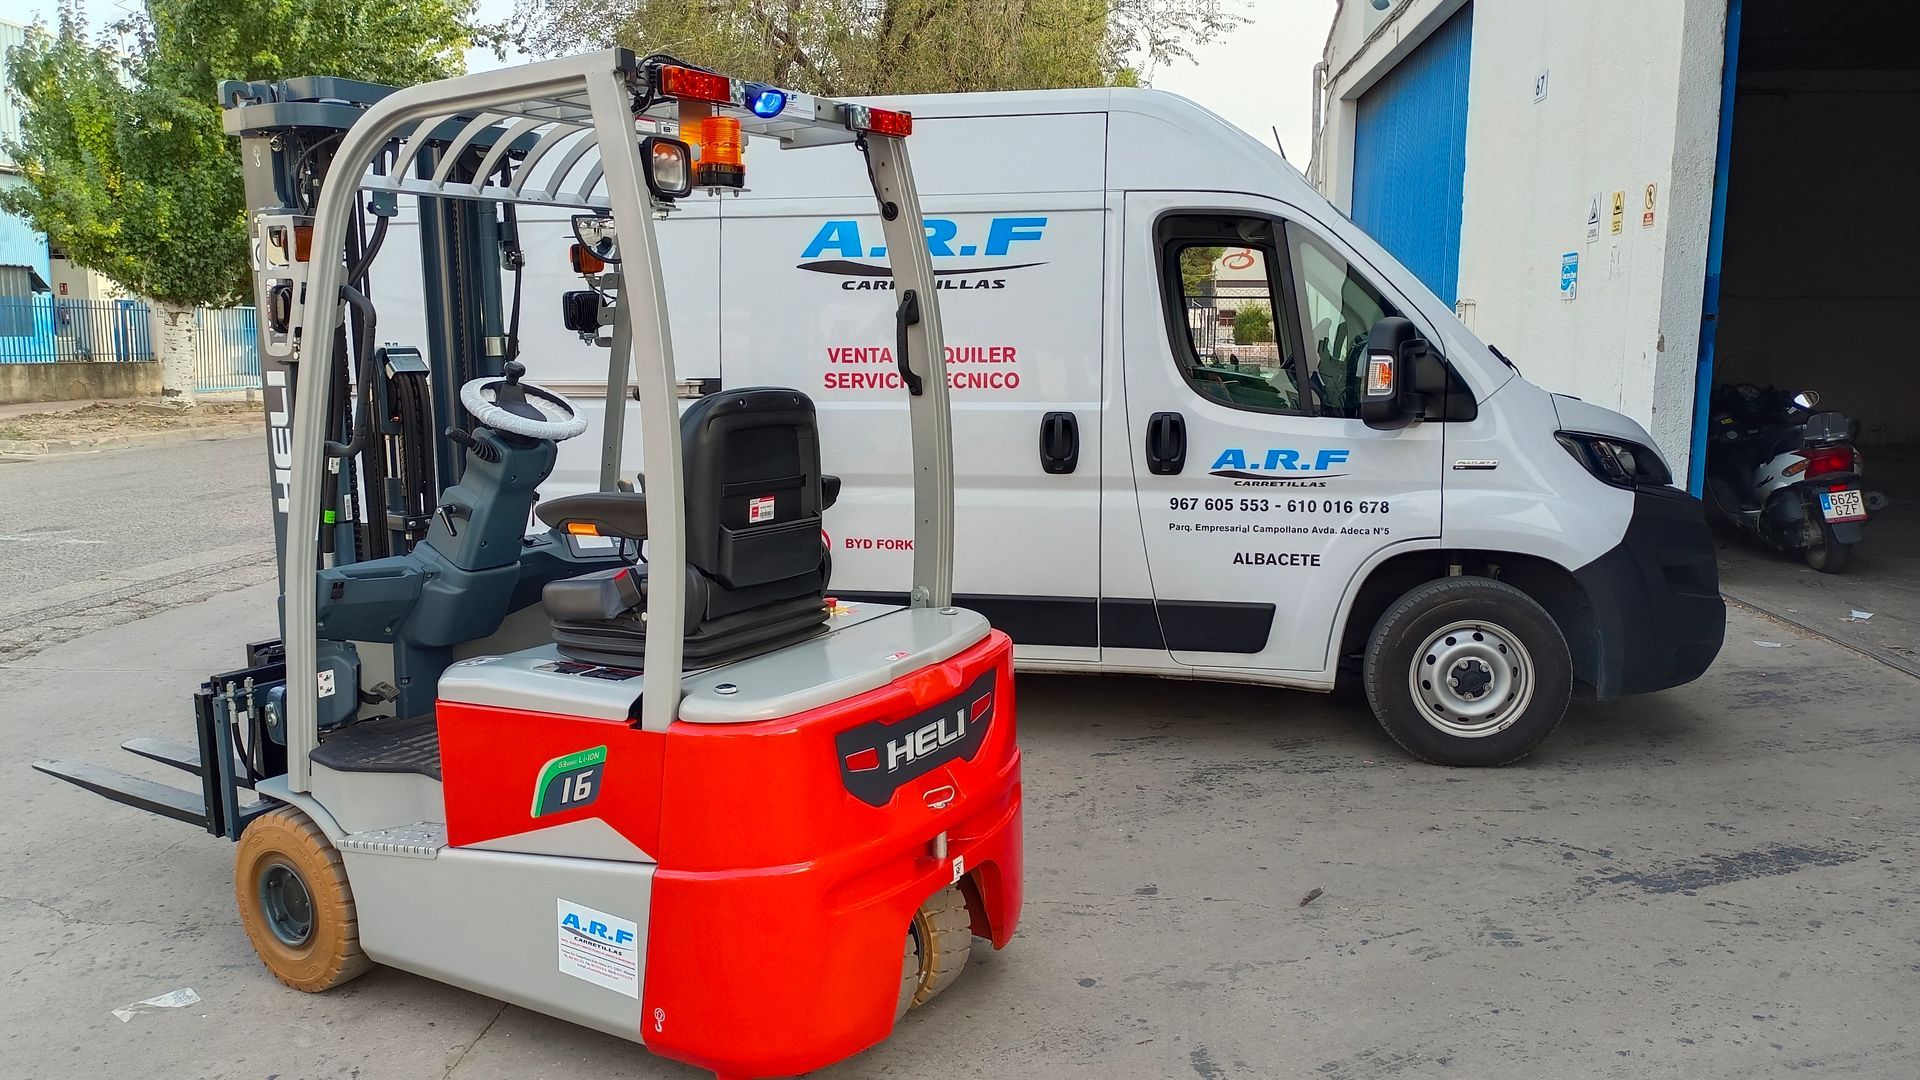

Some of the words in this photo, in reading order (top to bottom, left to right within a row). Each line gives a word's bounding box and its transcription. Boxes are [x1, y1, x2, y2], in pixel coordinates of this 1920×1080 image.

[1536, 75, 1545, 96] 67
[801, 217, 1048, 258] A.R.F
[841, 279, 1007, 290] CARILLAS
[827, 347, 893, 363] VENTA
[943, 346, 1017, 364] QUILER
[823, 372, 906, 389] SERVICI
[266, 370, 292, 513] HELI
[1211, 449, 1350, 470] A.R.F
[1233, 480, 1327, 488] CARRETILLAS
[1169, 497, 1199, 510] 967
[1204, 498, 1234, 511] 605
[1239, 498, 1269, 512] 553
[1287, 499, 1317, 513] 610
[1323, 500, 1353, 514] 016
[1359, 501, 1390, 514] 678
[1830, 492, 1860, 506] 6625
[1835, 503, 1858, 516] GZF
[1169, 523, 1193, 532] Parq.
[1195, 523, 1250, 534] Empresarial
[1252, 524, 1309, 535] Campollano
[1311, 526, 1338, 535] Avda.
[1340, 527, 1370, 535] Adeca
[845, 538, 873, 549] BYD
[876, 539, 914, 550] FORK
[1232, 552, 1321, 567] ALBACETE
[886, 708, 966, 771] HELI
[561, 769, 594, 804] 16
[562, 912, 634, 944] A.R.F
[573, 936, 623, 956] CARRETILLAS
